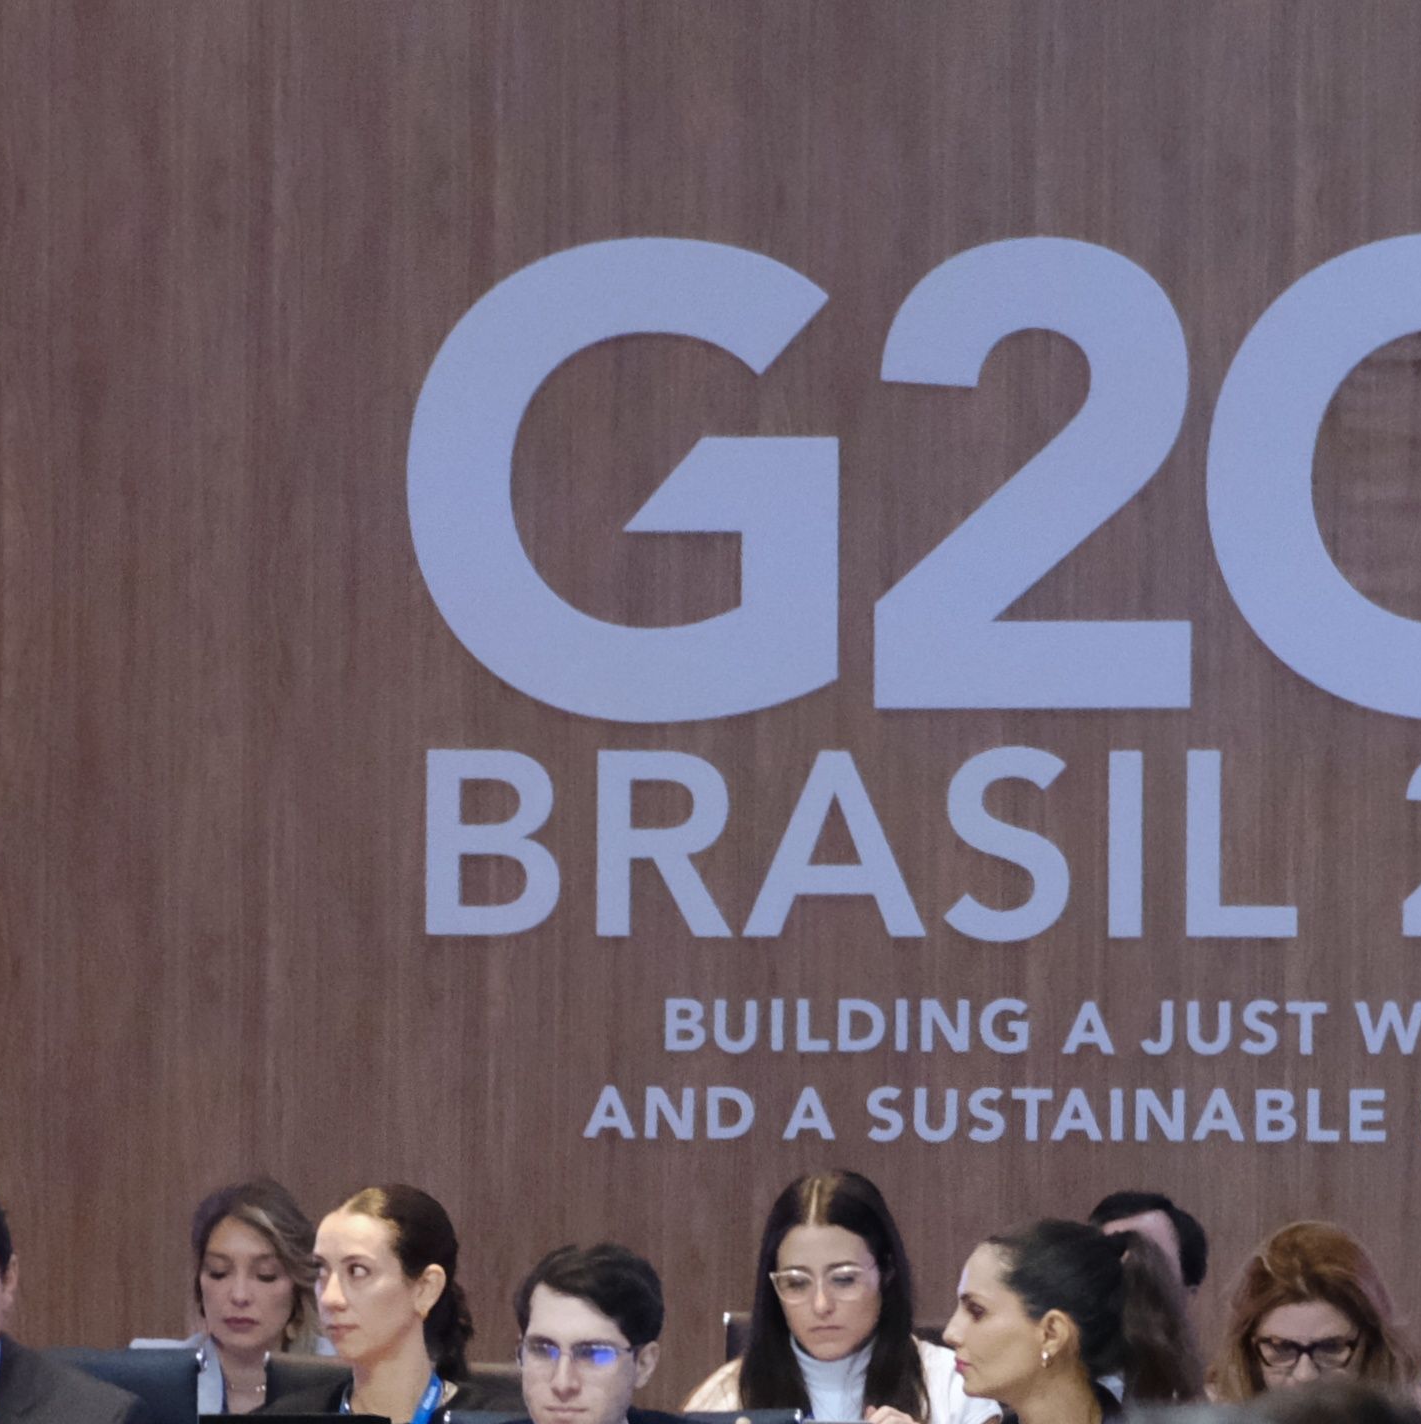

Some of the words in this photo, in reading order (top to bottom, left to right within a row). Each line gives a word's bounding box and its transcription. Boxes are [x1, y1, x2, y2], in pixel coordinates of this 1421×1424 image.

[425, 745, 1299, 943] BRASIL
[663, 997, 1031, 1055] BUILDING
[1063, 1000, 1115, 1055] A
[1141, 999, 1329, 1056] JUST
[583, 1086, 757, 1140] AND
[784, 1087, 835, 1140] A
[866, 1086, 1388, 1143] SUSTAINABLE
